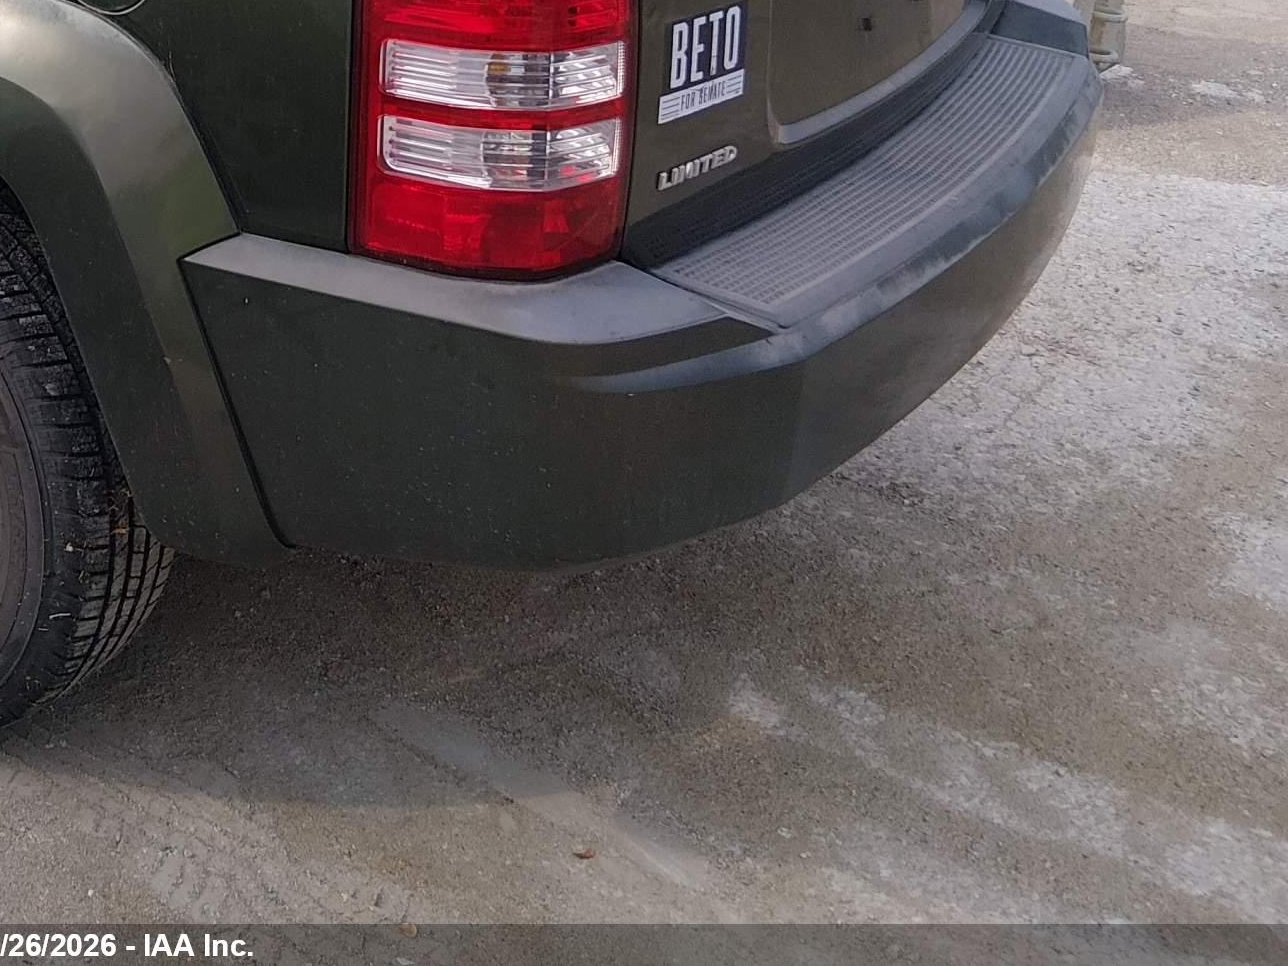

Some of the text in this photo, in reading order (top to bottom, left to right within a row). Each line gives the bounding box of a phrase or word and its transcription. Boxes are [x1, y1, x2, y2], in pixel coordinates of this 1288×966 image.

[669, 5, 741, 89] BETO
[680, 80, 726, 111] FOR SENATE
[657, 145, 738, 191] LIMITED
